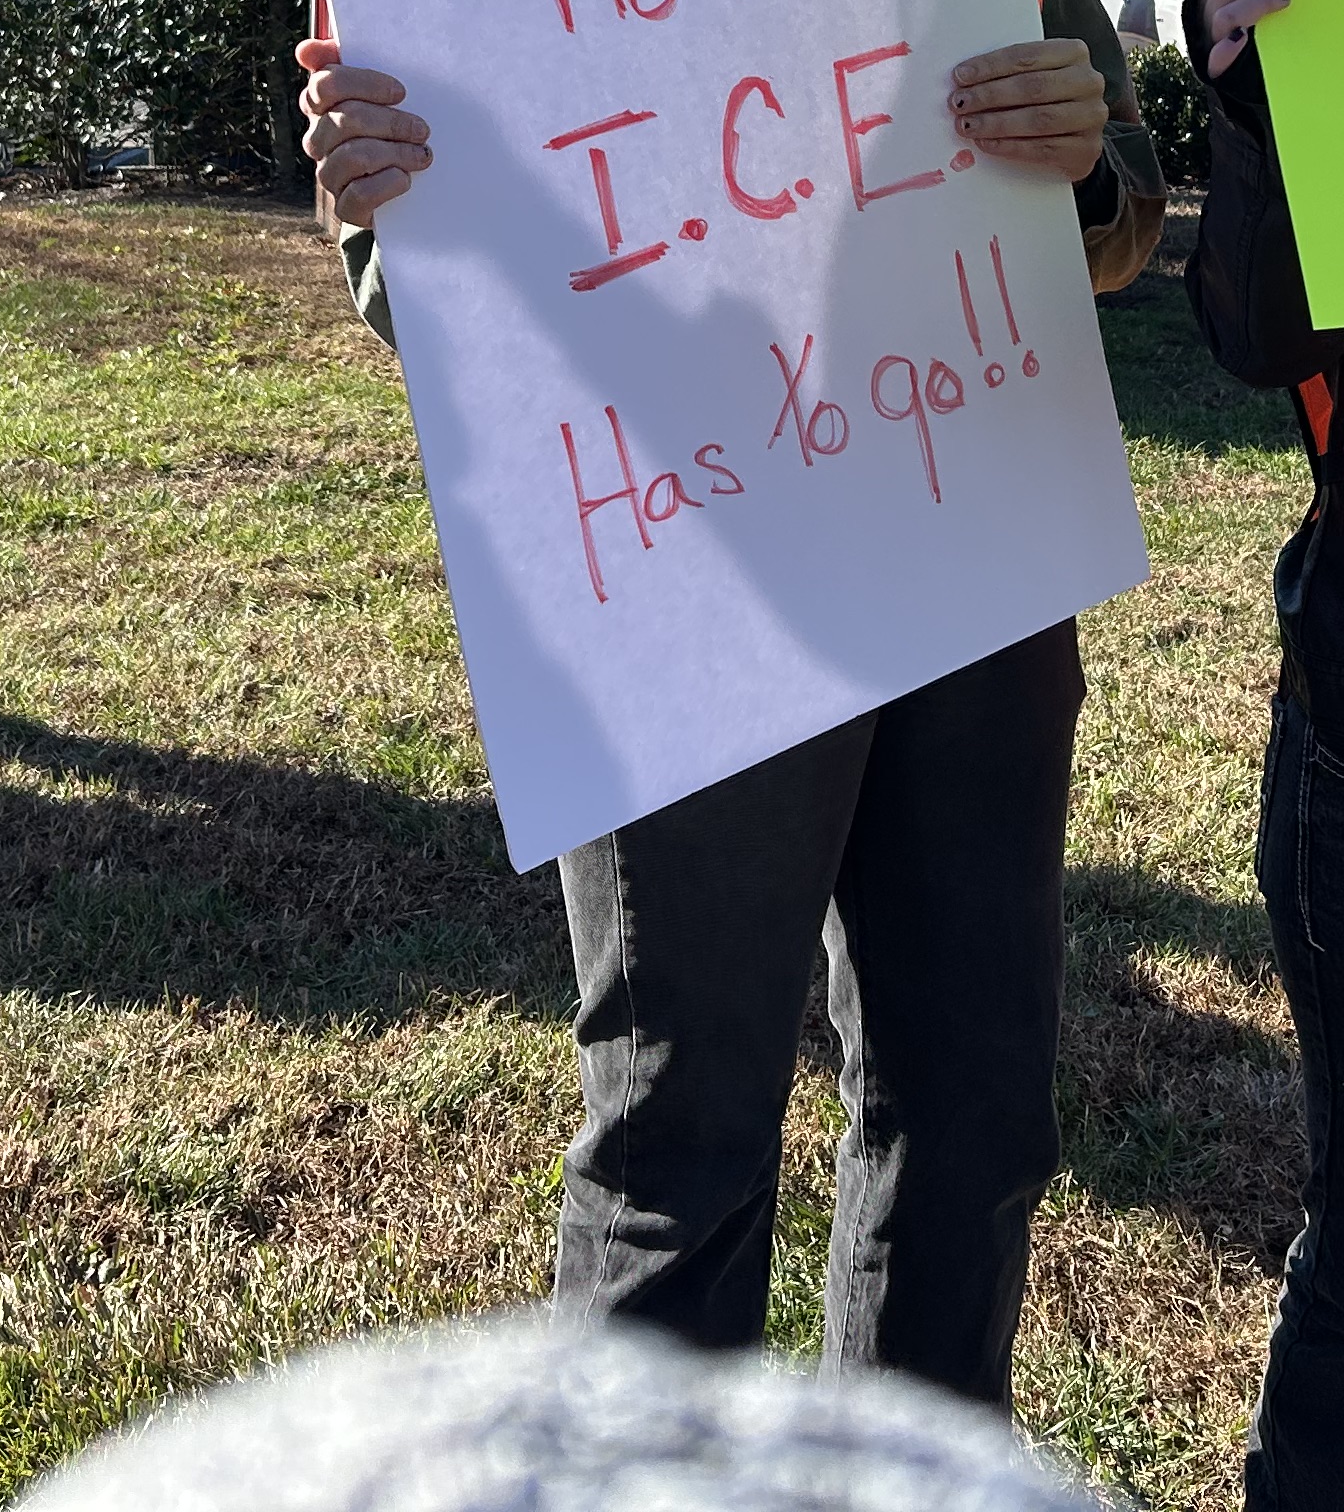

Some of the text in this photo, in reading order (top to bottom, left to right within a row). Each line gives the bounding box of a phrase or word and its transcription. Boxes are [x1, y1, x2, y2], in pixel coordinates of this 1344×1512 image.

[541, 40, 978, 292] I.C.E.
[561, 404, 746, 605] Has
[870, 235, 1042, 506] go!!
